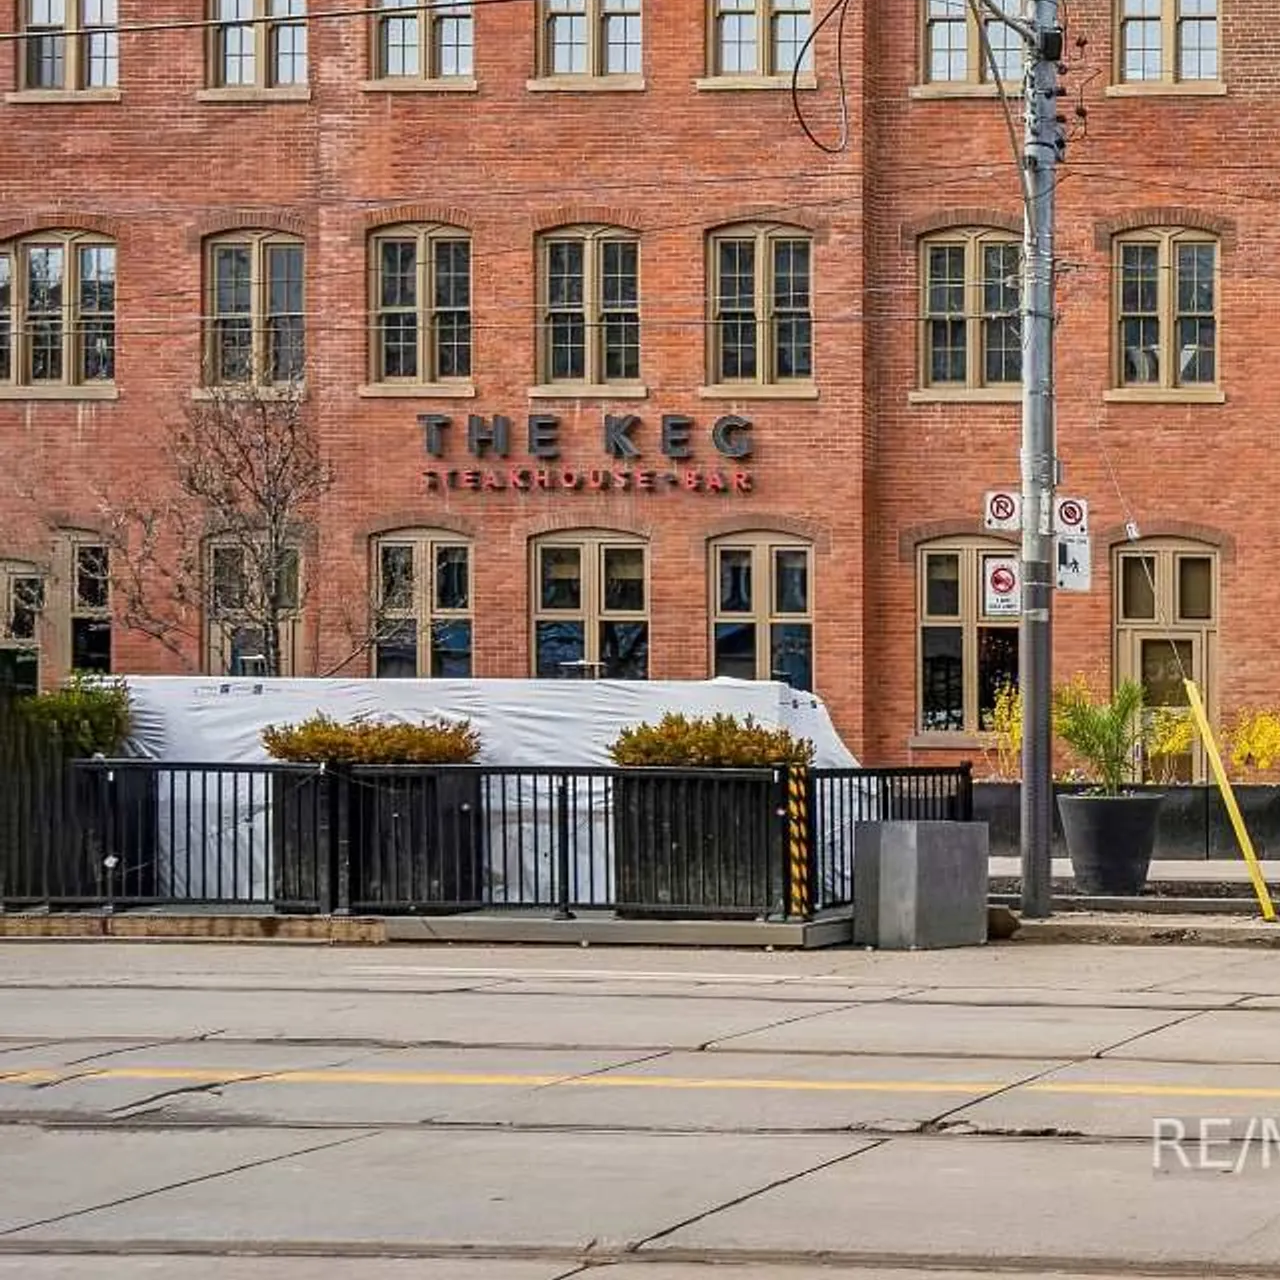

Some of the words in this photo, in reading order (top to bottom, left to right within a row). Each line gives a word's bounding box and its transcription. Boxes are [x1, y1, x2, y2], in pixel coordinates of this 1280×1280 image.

[416, 413, 563, 458] THE
[603, 413, 753, 458] KEG
[416, 468, 657, 490] STEAKHOUSE
[682, 469, 753, 490] BAR
